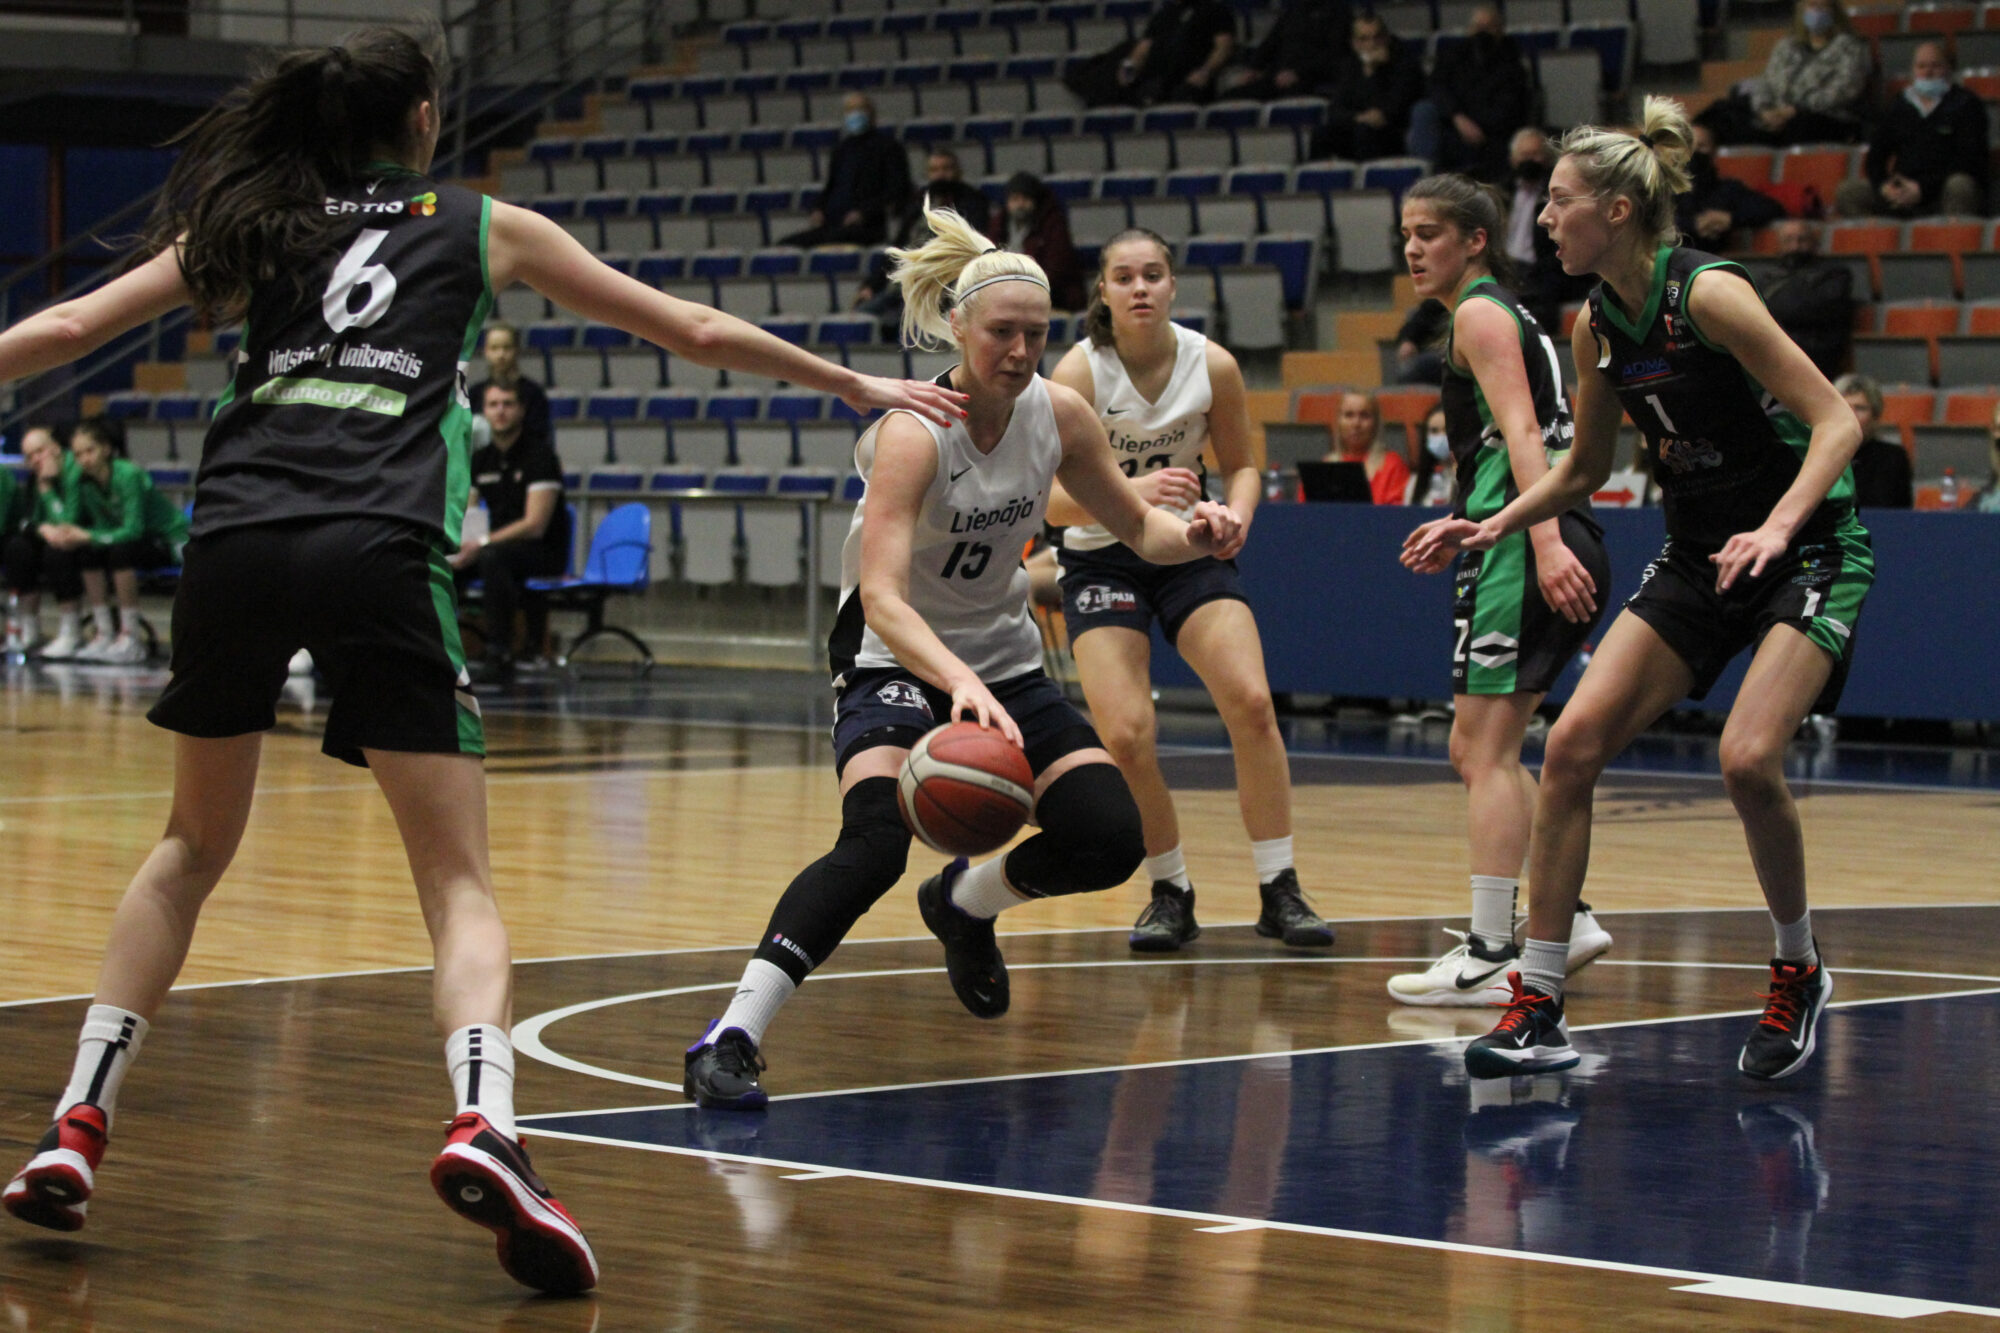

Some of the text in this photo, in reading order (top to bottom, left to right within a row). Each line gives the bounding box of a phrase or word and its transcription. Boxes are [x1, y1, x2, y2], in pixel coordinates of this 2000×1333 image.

[322, 228, 397, 333] 6
[1645, 394, 1678, 434] 1
[1109, 428, 1185, 454] Liepāja
[950, 496, 1034, 533] Liepāja
[940, 541, 993, 580] 15
[1801, 587, 1822, 621] 1
